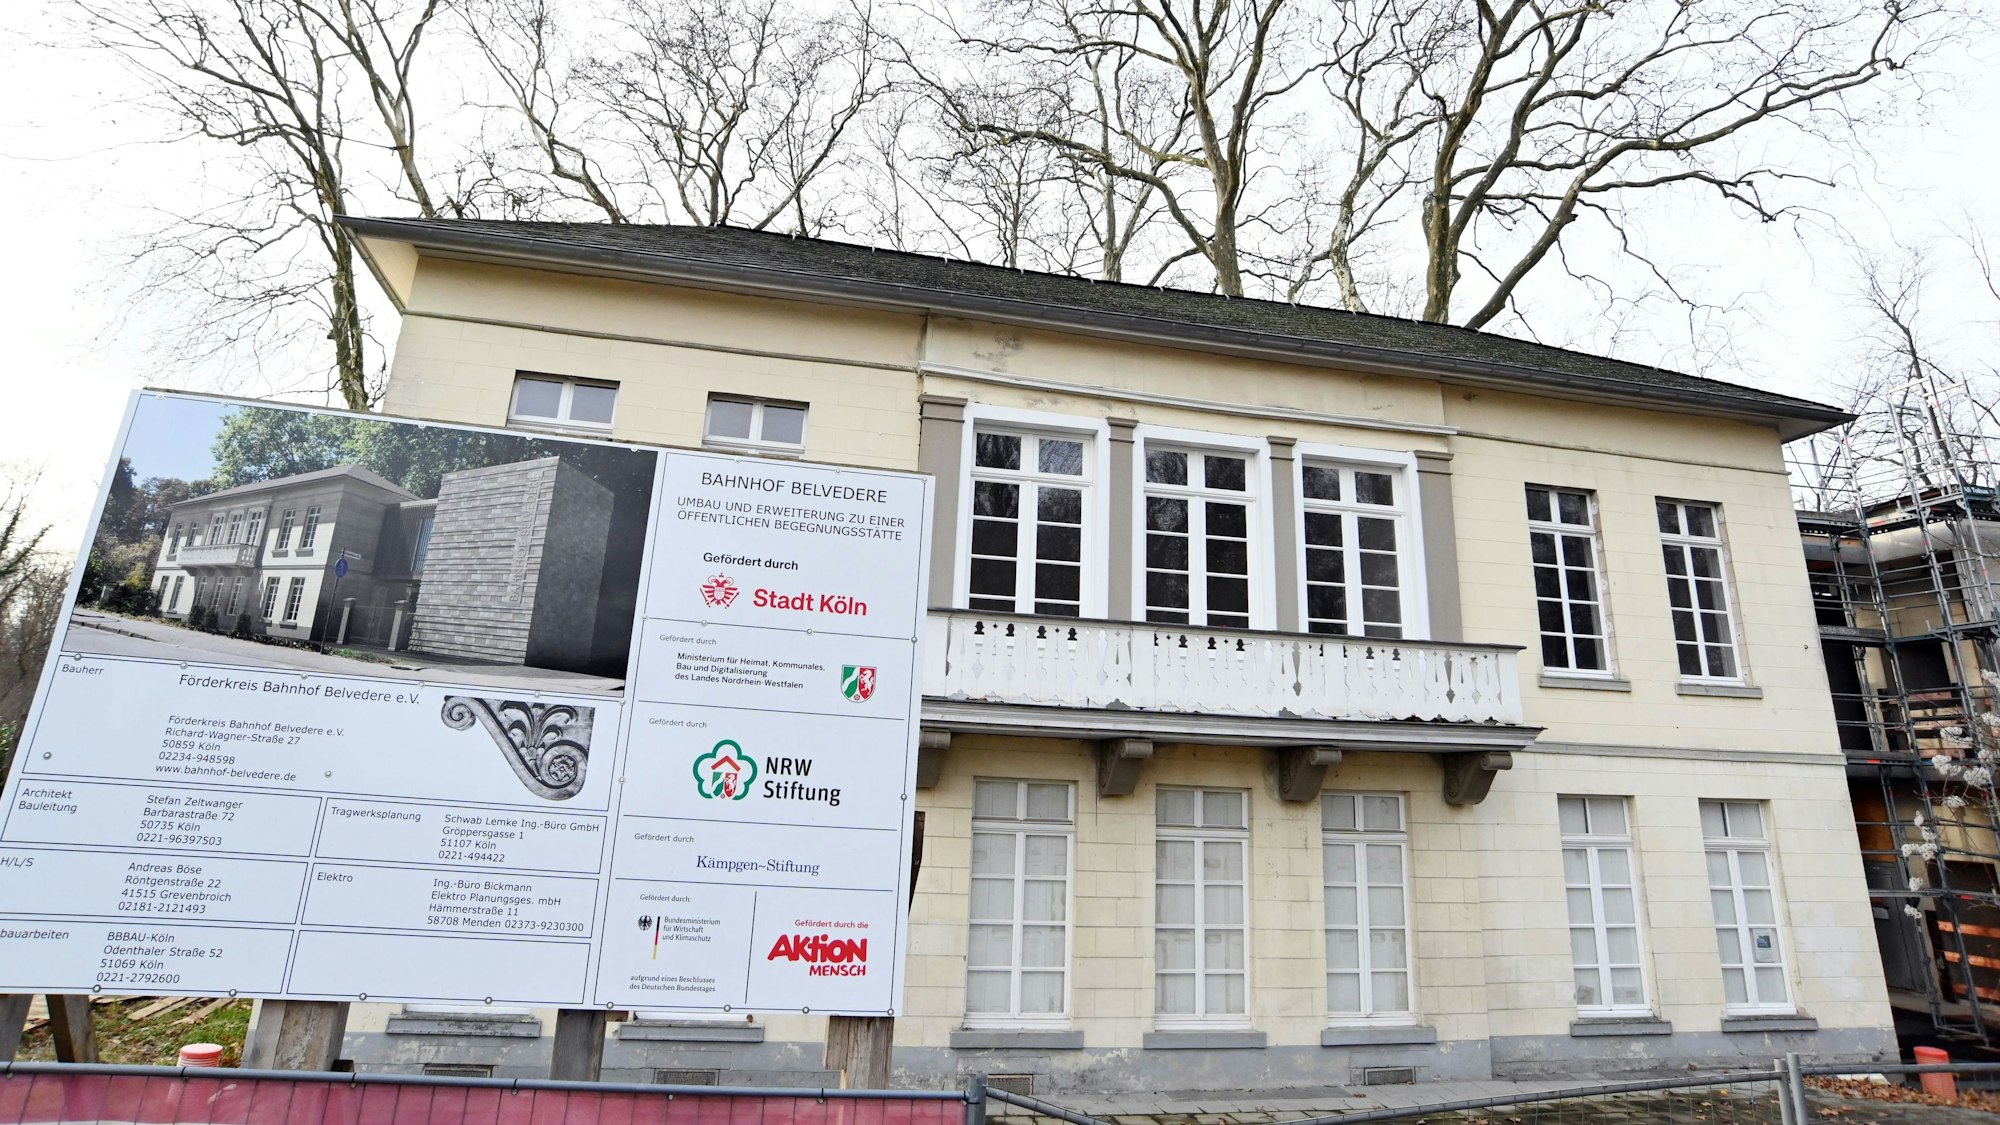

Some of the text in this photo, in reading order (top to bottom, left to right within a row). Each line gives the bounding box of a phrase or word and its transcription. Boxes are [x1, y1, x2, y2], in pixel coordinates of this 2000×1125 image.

[701, 472, 887, 503] BAHNHOF BELVEDERE
[677, 497, 905, 528] UMBAU UND ERWEITERUNG ZU EINER
[677, 509, 902, 541] ÖFFENTLICHEN BEGEGNUNGSSTÄTTE
[703, 552, 799, 570] Gefördert durch
[753, 588, 867, 616] Stadt Köln
[659, 634, 716, 645] Gefördert durch
[677, 652, 724, 663] Ministerium
[727, 656, 738, 664] für
[740, 657, 770, 667] Heimat,
[62, 664, 104, 676] Bauherr
[676, 662, 768, 677] Bau und Digitalisierung
[675, 672, 804, 689] des Landes Nordrhein-Westfalen
[179, 674, 420, 704] Förderkreis Bahnhof Belvedere e.V.
[168, 715, 344, 737] Förderkreis Bahnhof Belvedere e.V.
[649, 717, 707, 728] Gefördert durch
[165, 728, 300, 745] Richard-Wagner-Straße 27
[162, 740, 221, 752] 50859 Köln
[159, 752, 235, 765] 02234-948598
[155, 764, 296, 782] www.bahnhof-belvedere.de
[766, 757, 812, 776] NRW
[22, 788, 73, 800] Architekt
[763, 781, 841, 806] Stiftung
[18, 801, 78, 814] Bauleitung
[147, 794, 243, 810] Stefan Zeltwanger
[143, 808, 235, 821] Barbarastraße 72
[331, 806, 421, 822] Tragwerksplanung
[140, 820, 200, 832] 50735 Köln
[444, 814, 600, 832] Schwab Lemke Ing.-Büro GmbH
[136, 832, 222, 846] 0221-96397503
[442, 827, 516, 840] Gröppersgasse
[634, 832, 694, 843] Gefördert durch
[440, 838, 496, 850] 51107 Köln
[1, 856, 34, 868] H/L/S
[438, 851, 505, 862] 0221-494422
[128, 862, 202, 875] Andreas Böse
[124, 875, 221, 888] Röntgenstraße 22
[317, 872, 353, 883] Elektro
[433, 879, 532, 892] Ing.-Büro Bickmann
[122, 888, 232, 902] 41515 Grevenbroich
[431, 891, 561, 906] Elektro Planungsges. mbH
[640, 894, 670, 902] Gefördert
[118, 901, 206, 914] 02181-2121493
[429, 904, 519, 916] Hämmerstraße 11
[427, 916, 584, 932] 58708 Menden 02373-9230300
[664, 916, 720, 925] Bundesministerium
[794, 919, 832, 929] Gefördert
[107, 931, 175, 943] BBBAU-Köln
[103, 945, 223, 958] Odenthaler Straße 52
[100, 958, 164, 970] 51069 Köln
[809, 964, 866, 977] MENSCH
[96, 972, 180, 984] 0221-2792600
[676, 985, 716, 993] Bundestages
